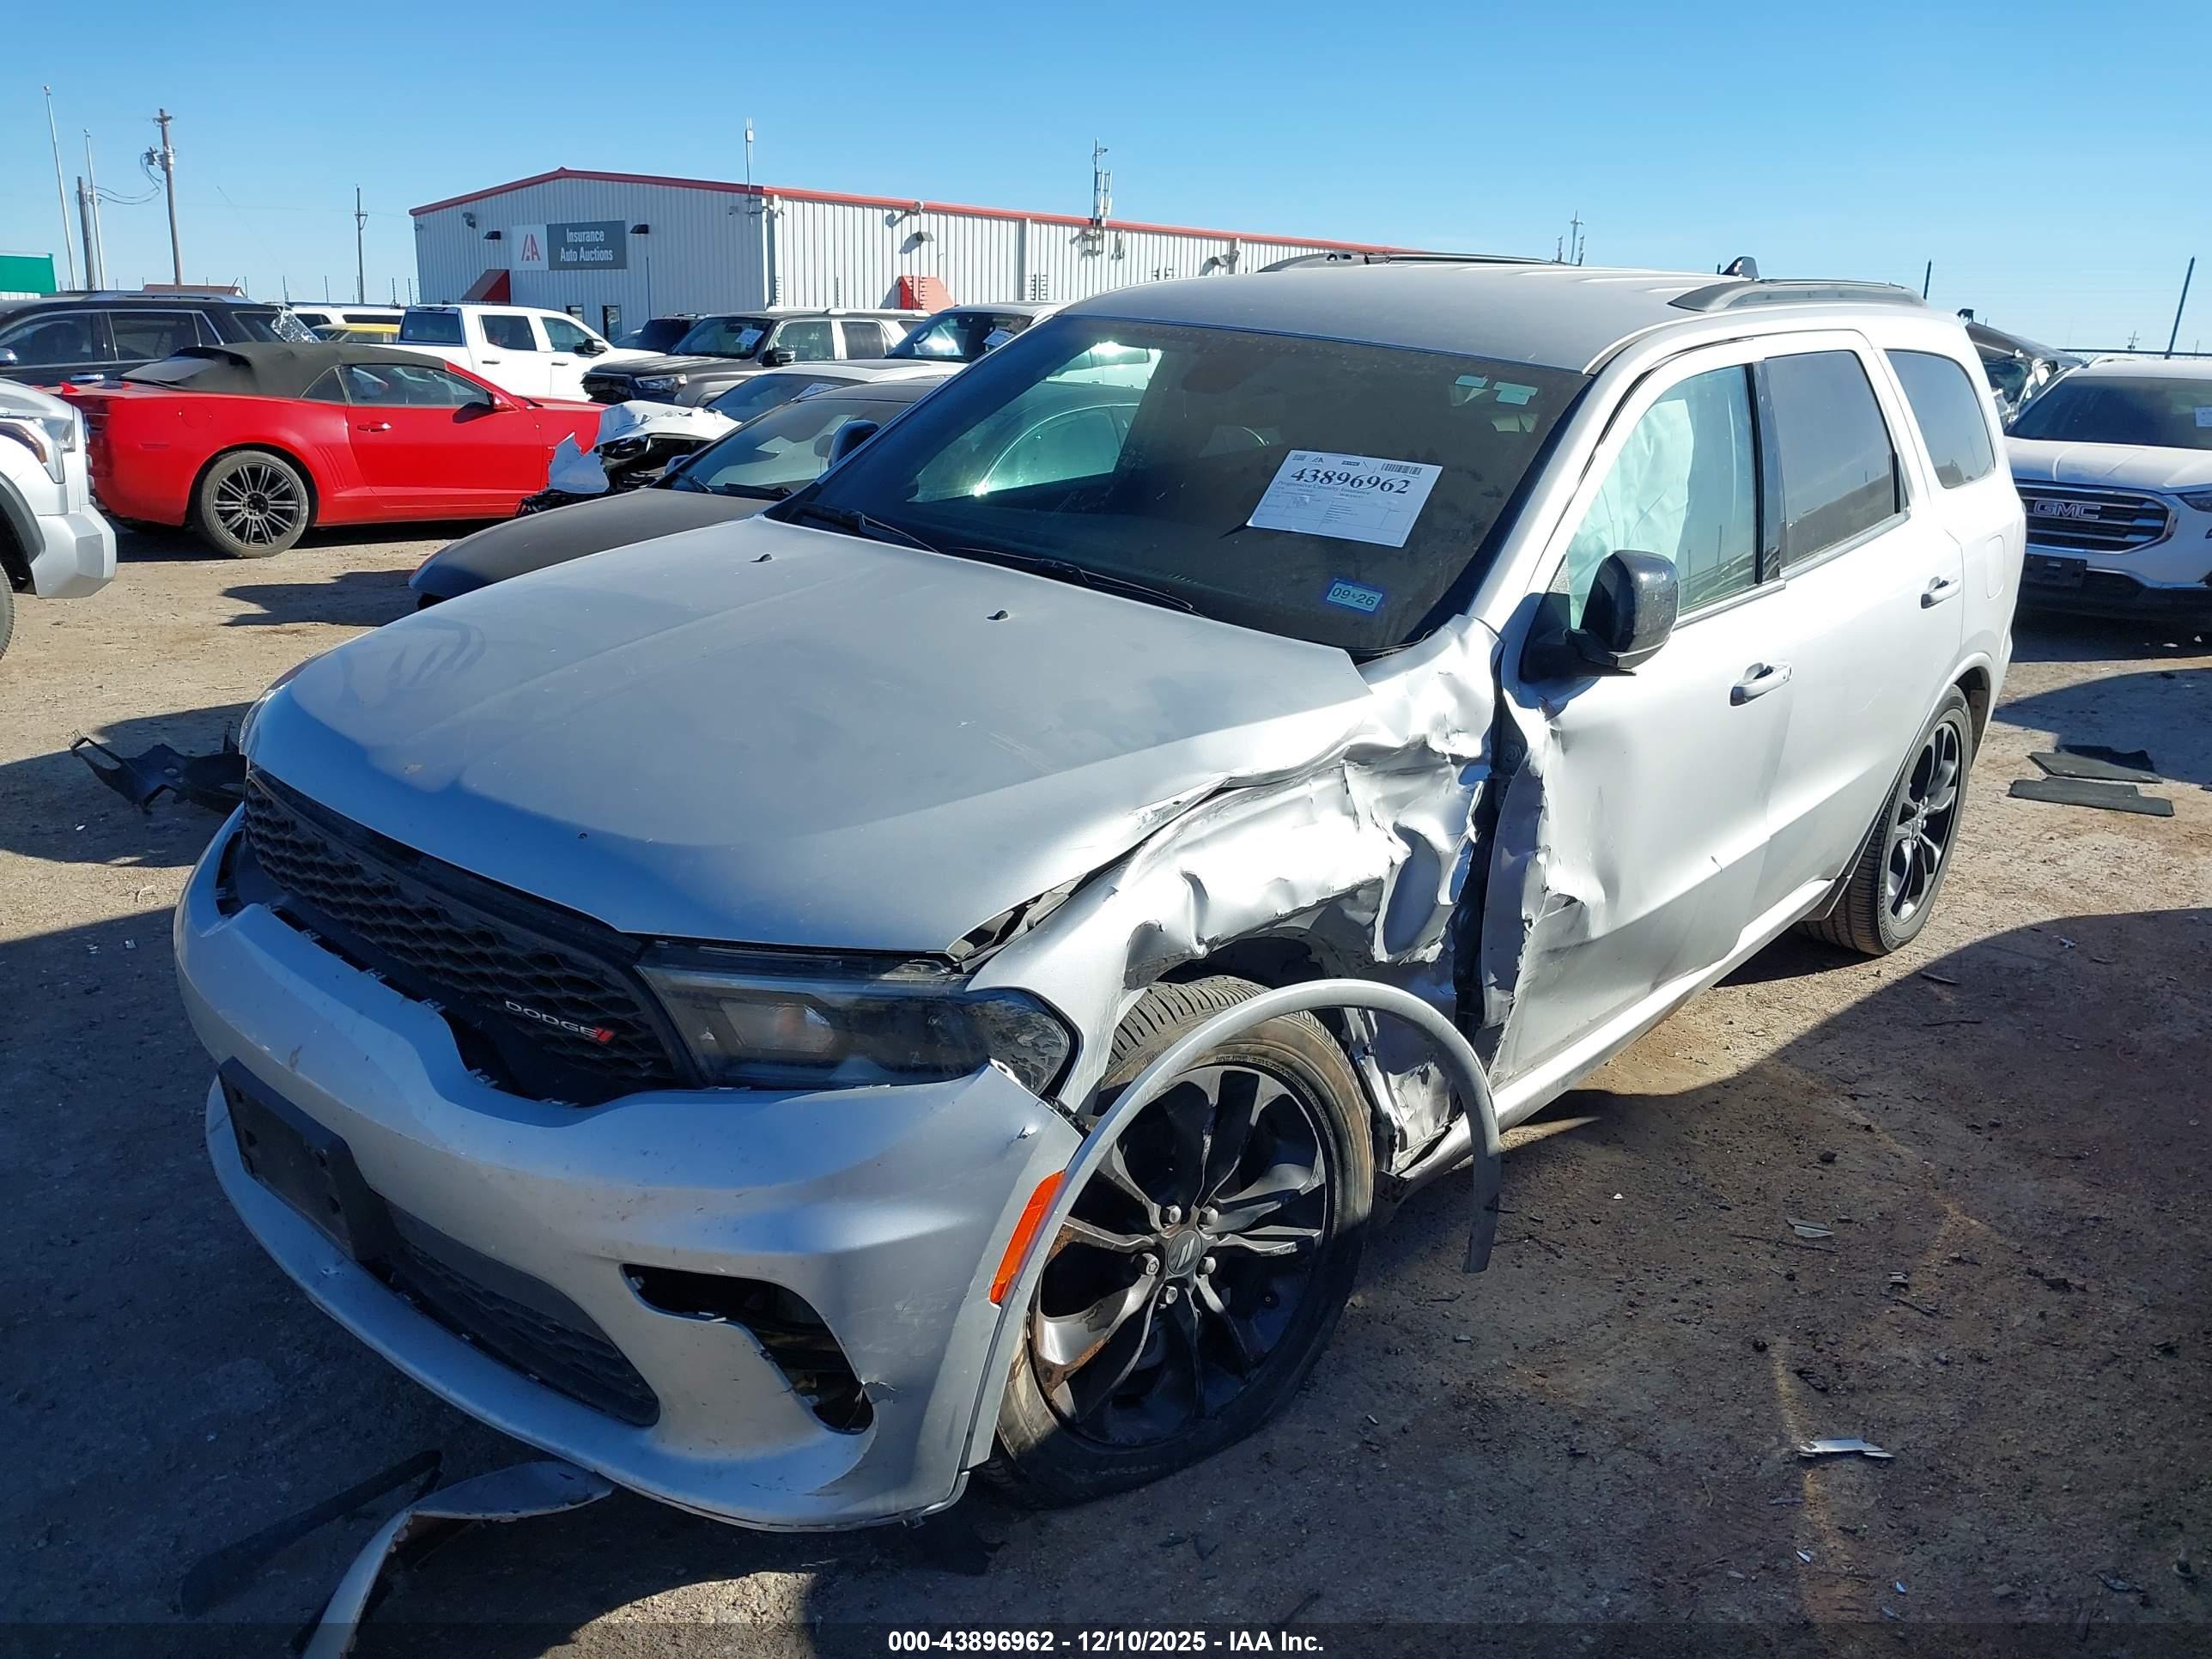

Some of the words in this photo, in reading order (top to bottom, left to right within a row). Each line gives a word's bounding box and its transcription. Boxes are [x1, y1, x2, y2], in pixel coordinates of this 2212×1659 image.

[566, 228, 605, 243] Insurance
[560, 247, 578, 262] Auto
[579, 246, 614, 262] Auctions
[1291, 467, 1412, 495] 43896962
[2033, 500, 2101, 520] GMC
[505, 1000, 599, 1038] DODGE
